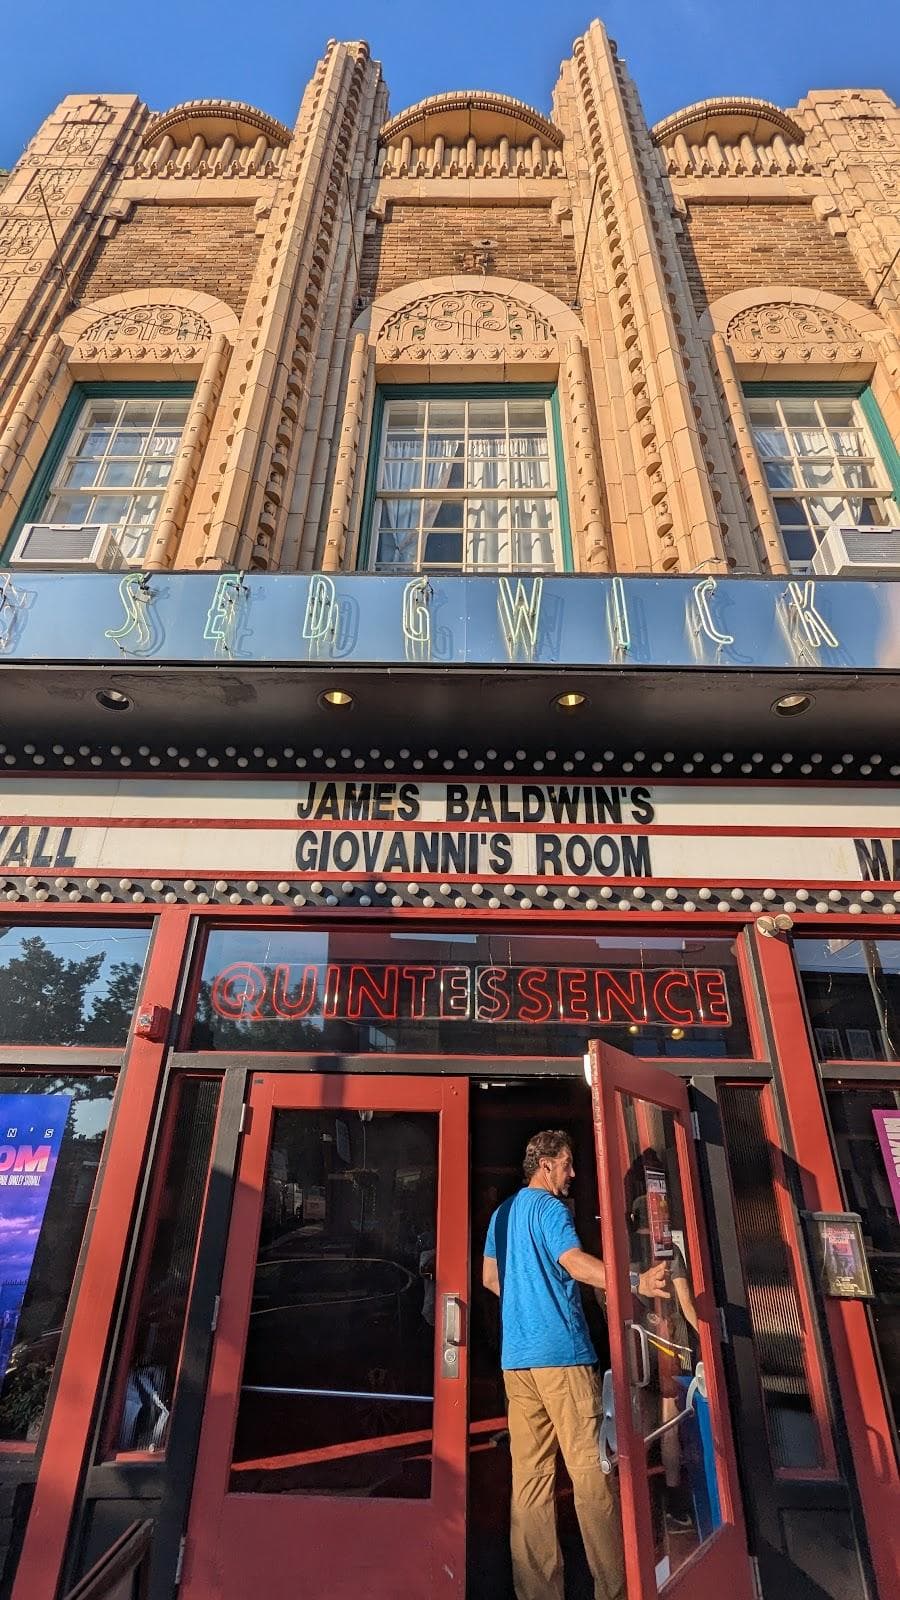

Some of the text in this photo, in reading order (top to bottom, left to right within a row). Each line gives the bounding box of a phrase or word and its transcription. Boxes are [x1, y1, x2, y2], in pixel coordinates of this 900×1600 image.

[105, 573, 838, 648] SEDGWICK
[297, 782, 655, 825] JAMES BALDWIN'S
[296, 830, 653, 878] GIOVANNI'S ROOM
[211, 961, 731, 1025] QUINTESSENCE
